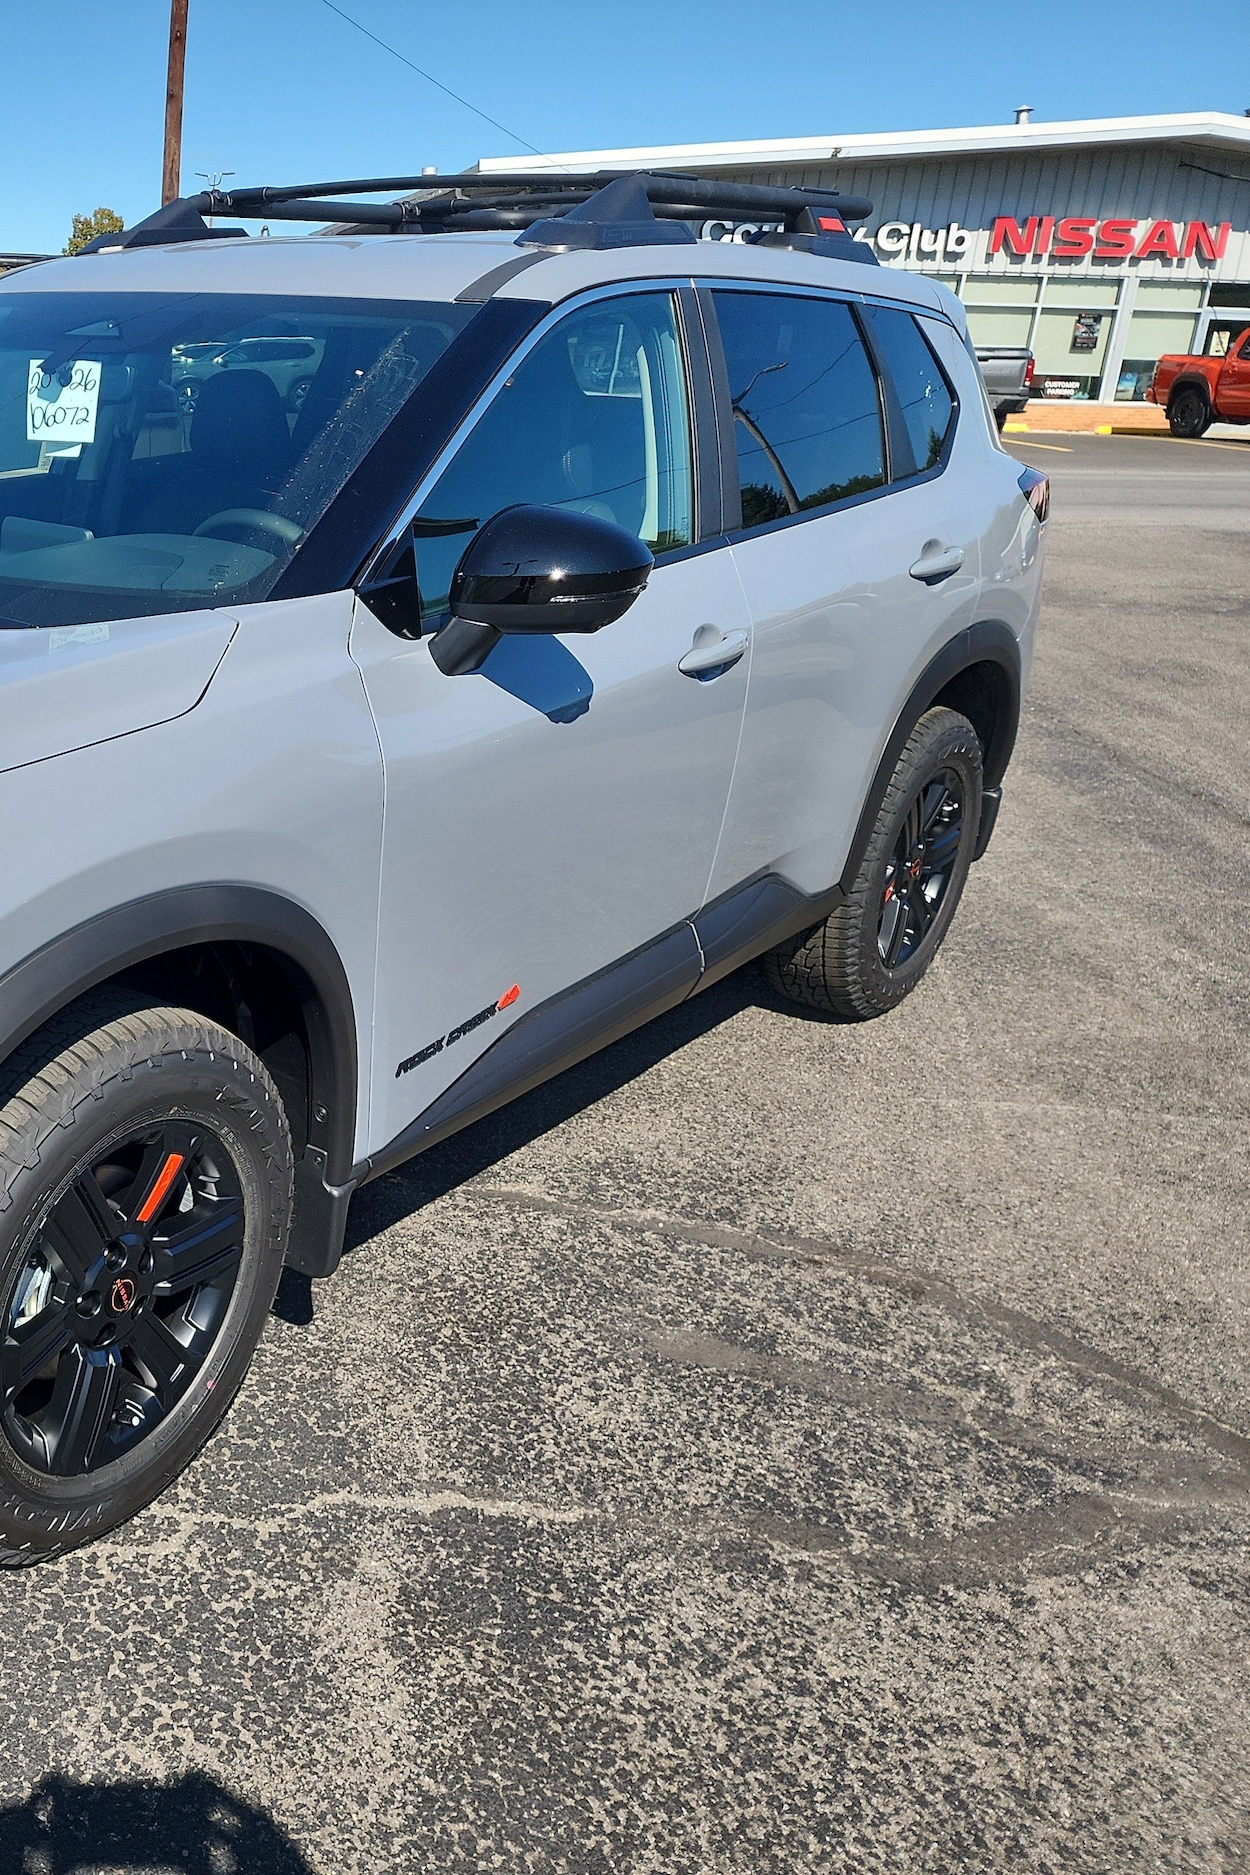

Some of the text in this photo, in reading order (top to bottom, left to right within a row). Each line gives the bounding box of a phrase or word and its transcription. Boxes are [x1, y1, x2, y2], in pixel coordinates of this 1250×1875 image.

[877, 221, 973, 252] Club
[991, 216, 1232, 259] NISSAN
[1044, 381, 1080, 389] CUSTOMER
[1046, 388, 1075, 396] PARKING
